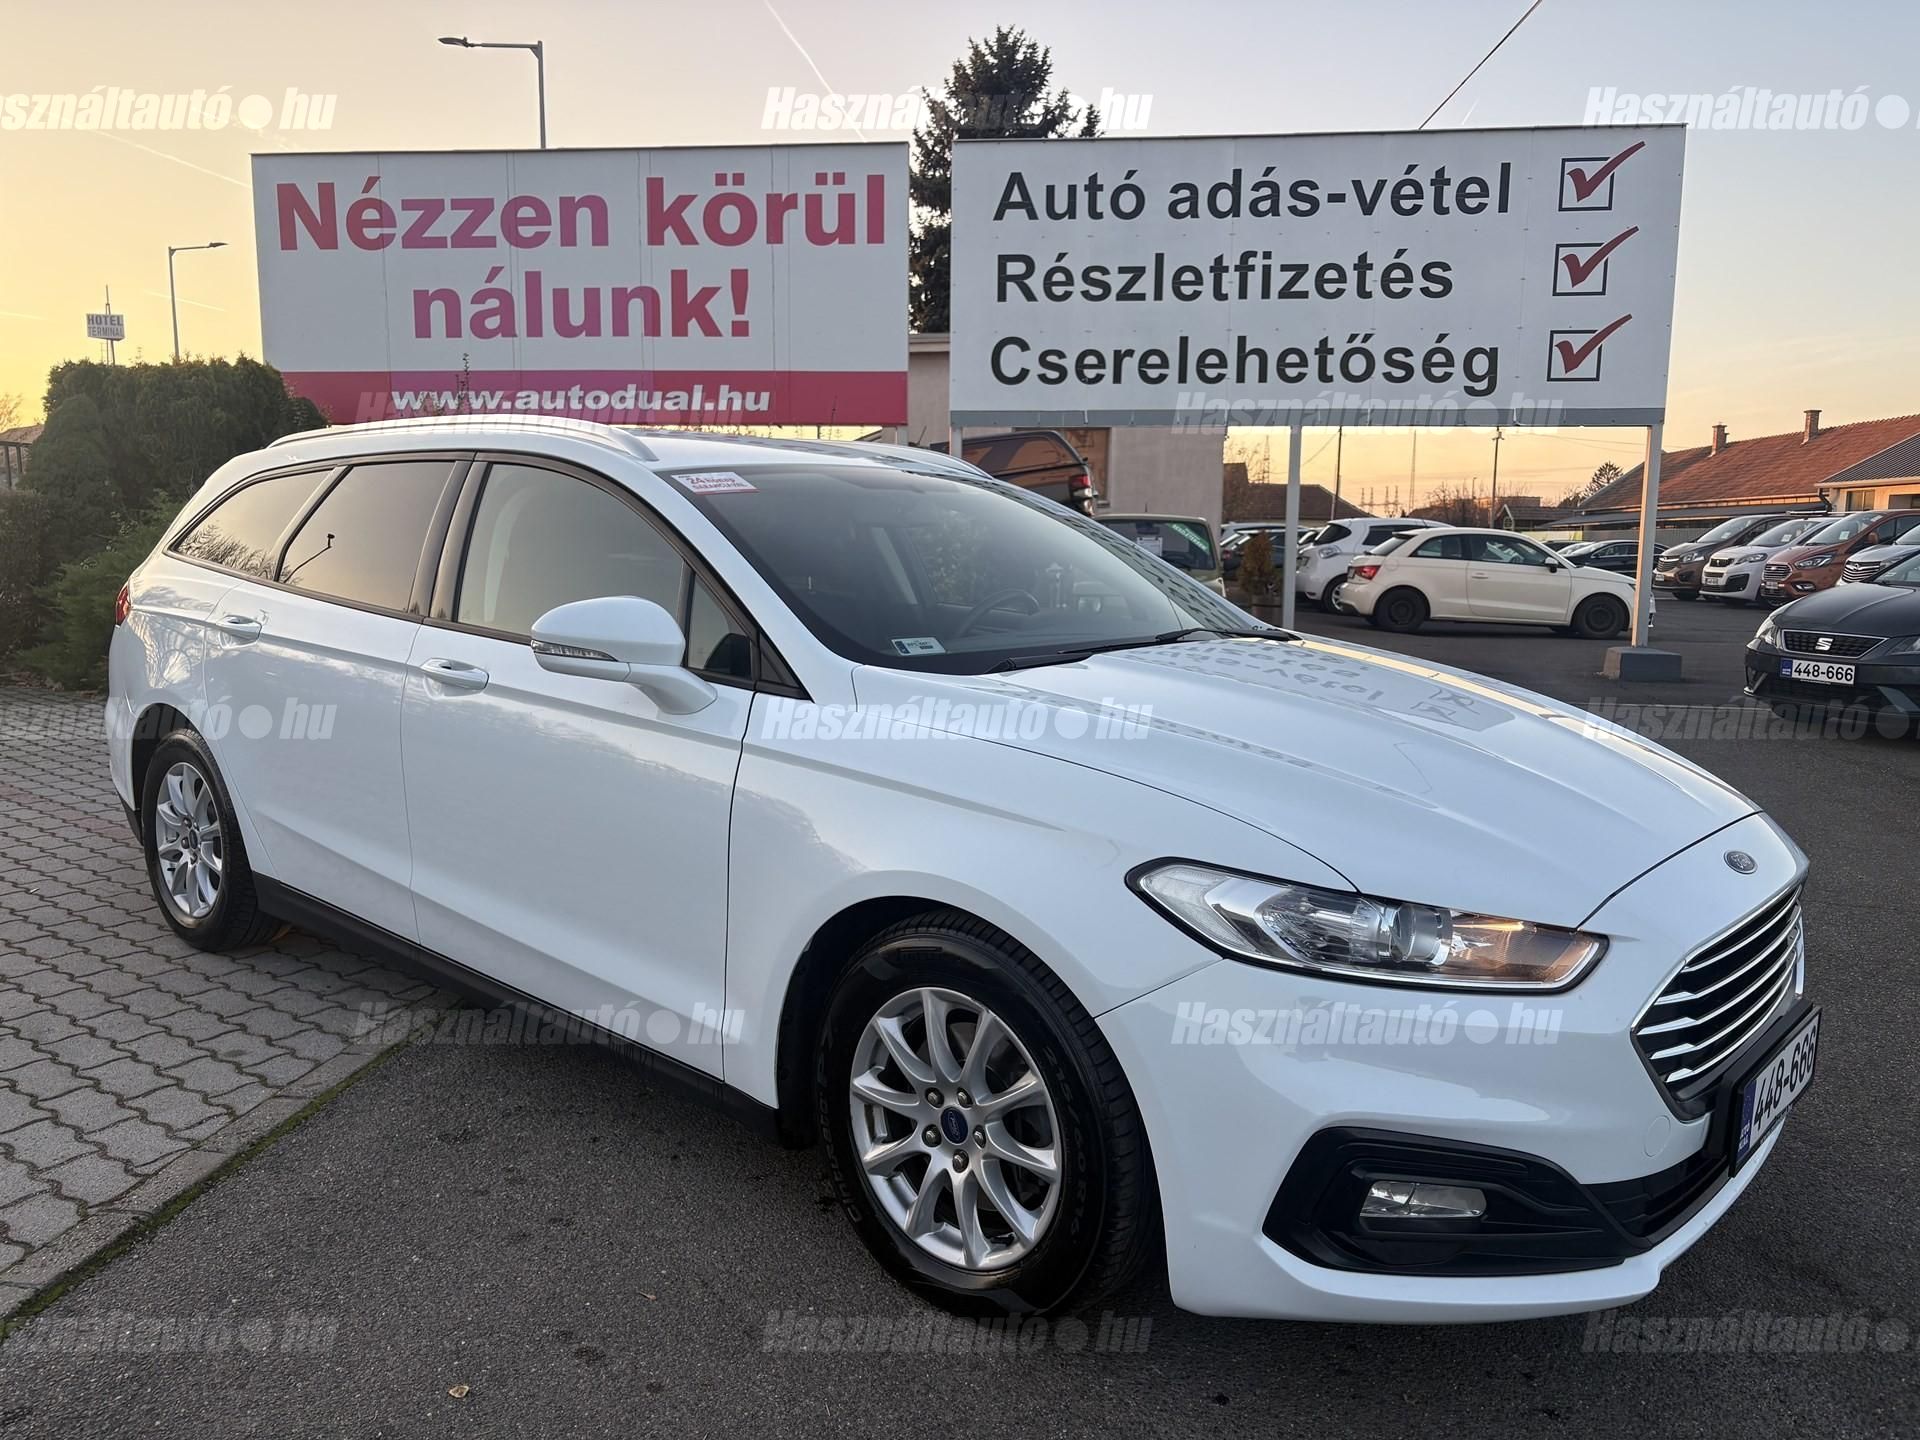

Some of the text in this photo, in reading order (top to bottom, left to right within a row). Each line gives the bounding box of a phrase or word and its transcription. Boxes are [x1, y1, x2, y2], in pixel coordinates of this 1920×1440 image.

[277, 172, 885, 250] Nézzen körül
[993, 162, 1511, 221] Autó adás-vétel
[413, 266, 749, 339] nálunk!
[997, 249, 1453, 303] Részletfizetés
[87, 314, 123, 326] HOTEL
[991, 333, 1499, 396] Cserelehetőség
[392, 384, 770, 411] www.autodual.hu
[1794, 662, 1853, 682] 448-666
[1754, 1025, 1816, 1131] 448-666
